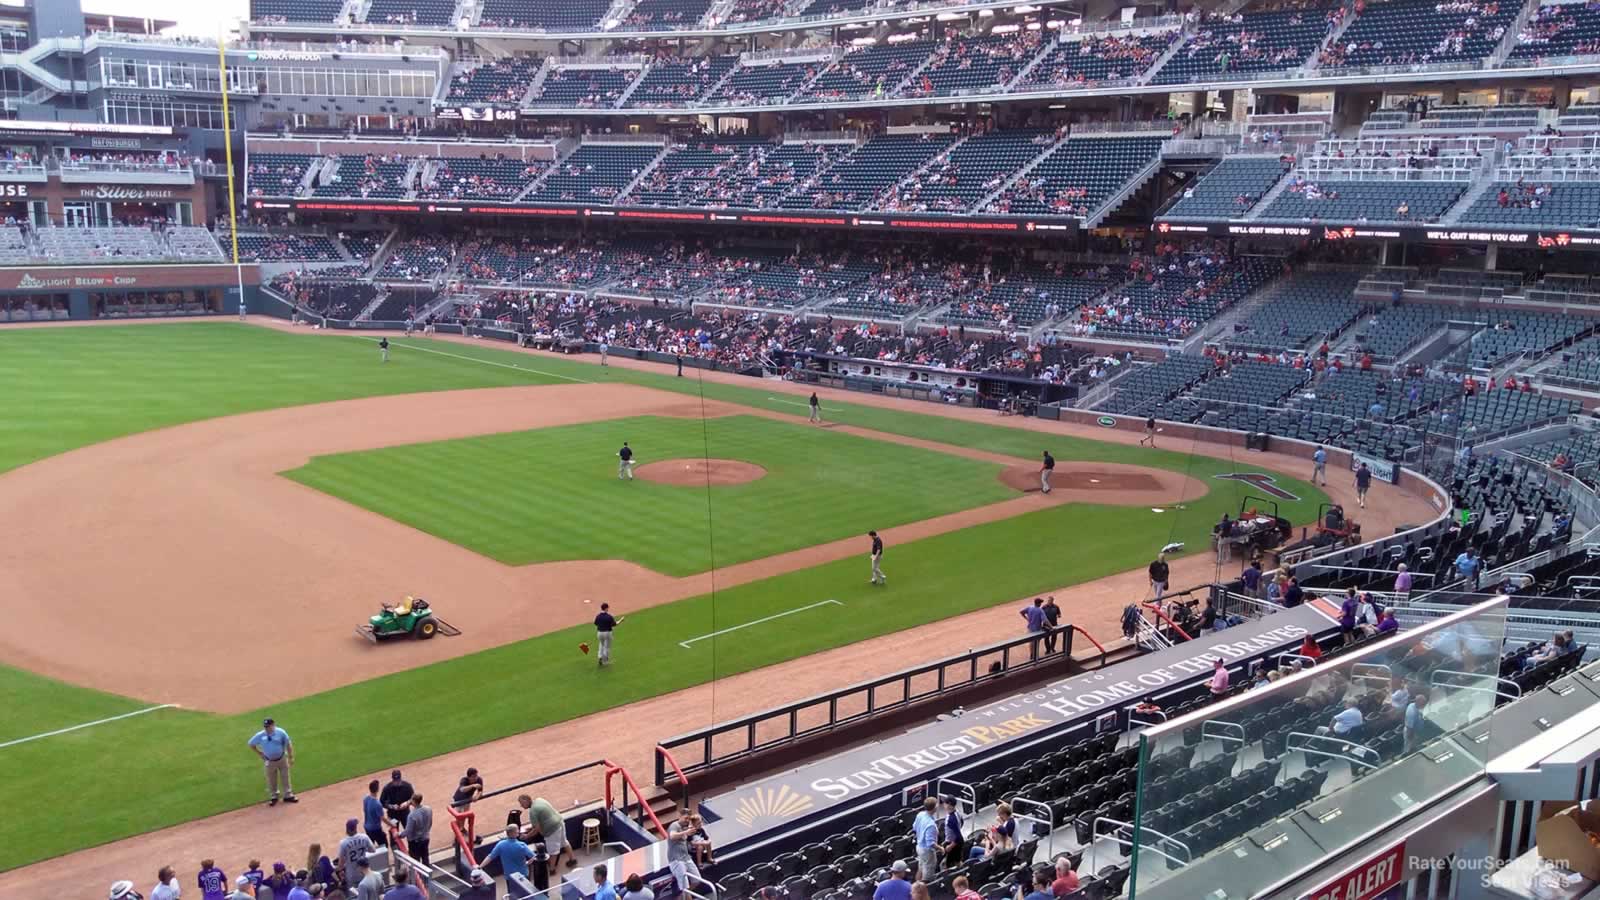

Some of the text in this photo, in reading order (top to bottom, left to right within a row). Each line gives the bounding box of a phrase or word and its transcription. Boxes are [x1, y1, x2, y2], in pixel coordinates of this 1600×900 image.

[496, 110, 516, 120] 6:45
[80, 185, 172, 199] THE Silver BULLET
[1285, 227, 1299, 235] YOU
[1427, 231, 1449, 239] WE'LL
[1468, 232, 1491, 240] WHEN
[1492, 233, 1508, 241] YOU
[1509, 234, 1528, 242] QUIT
[1041, 678, 1143, 717] HOME
[1137, 666, 1176, 687] OF
[1169, 650, 1226, 676] THE
[1212, 624, 1309, 659] BRAVES
[982, 673, 1104, 719] WELCOME TO
[1345, 853, 1398, 900] ALERT
[205, 877, 219, 893] 19
